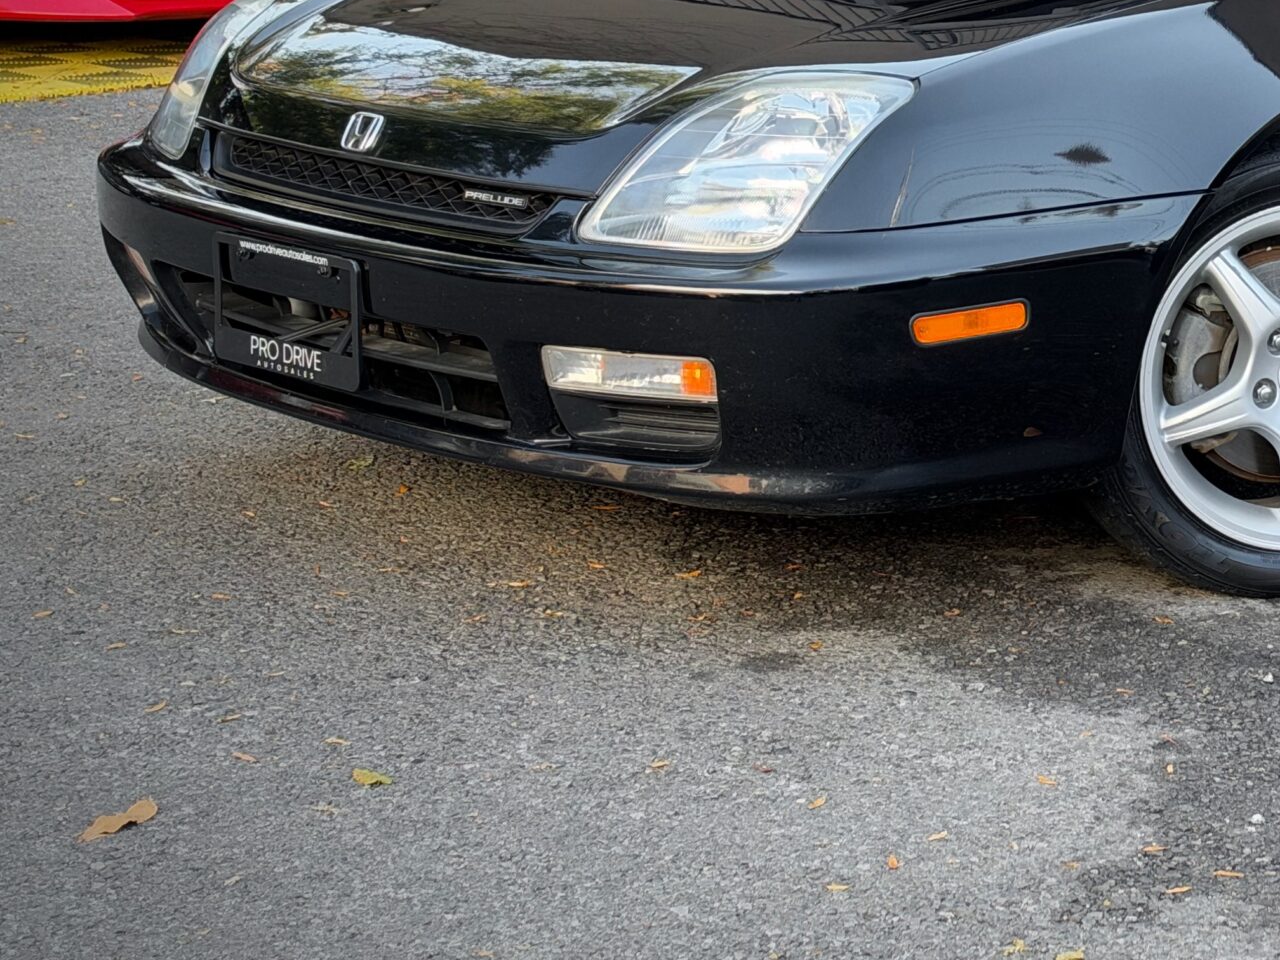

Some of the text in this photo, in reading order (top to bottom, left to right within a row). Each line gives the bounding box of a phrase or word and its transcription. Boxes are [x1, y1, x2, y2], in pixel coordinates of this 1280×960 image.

[464, 190, 525, 206] PRELUDE
[250, 335, 323, 372] PRO DRIVE
[256, 360, 315, 380] AUTOSALES
